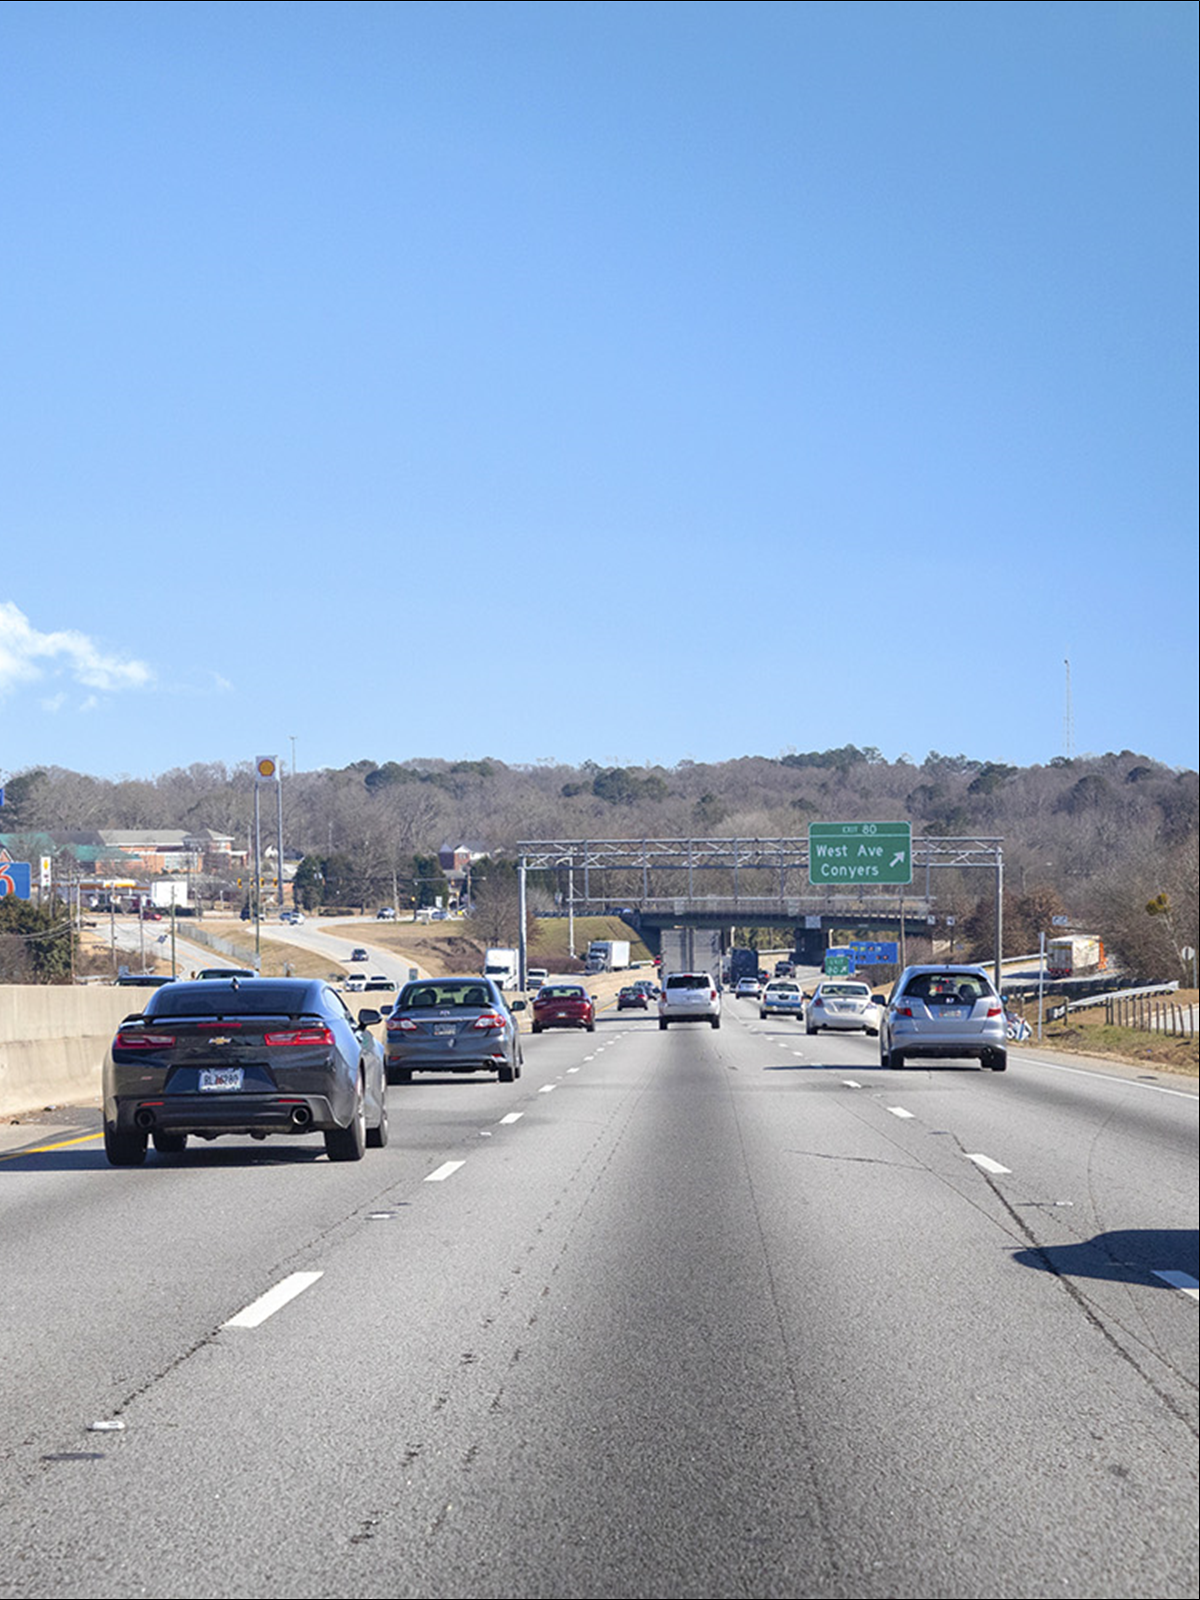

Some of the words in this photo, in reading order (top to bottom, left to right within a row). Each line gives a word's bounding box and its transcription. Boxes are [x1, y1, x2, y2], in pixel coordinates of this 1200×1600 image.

[862, 824, 877, 834] 80
[816, 845, 848, 857] West
[857, 845, 884, 857] Ave
[820, 863, 879, 879] Conyers
